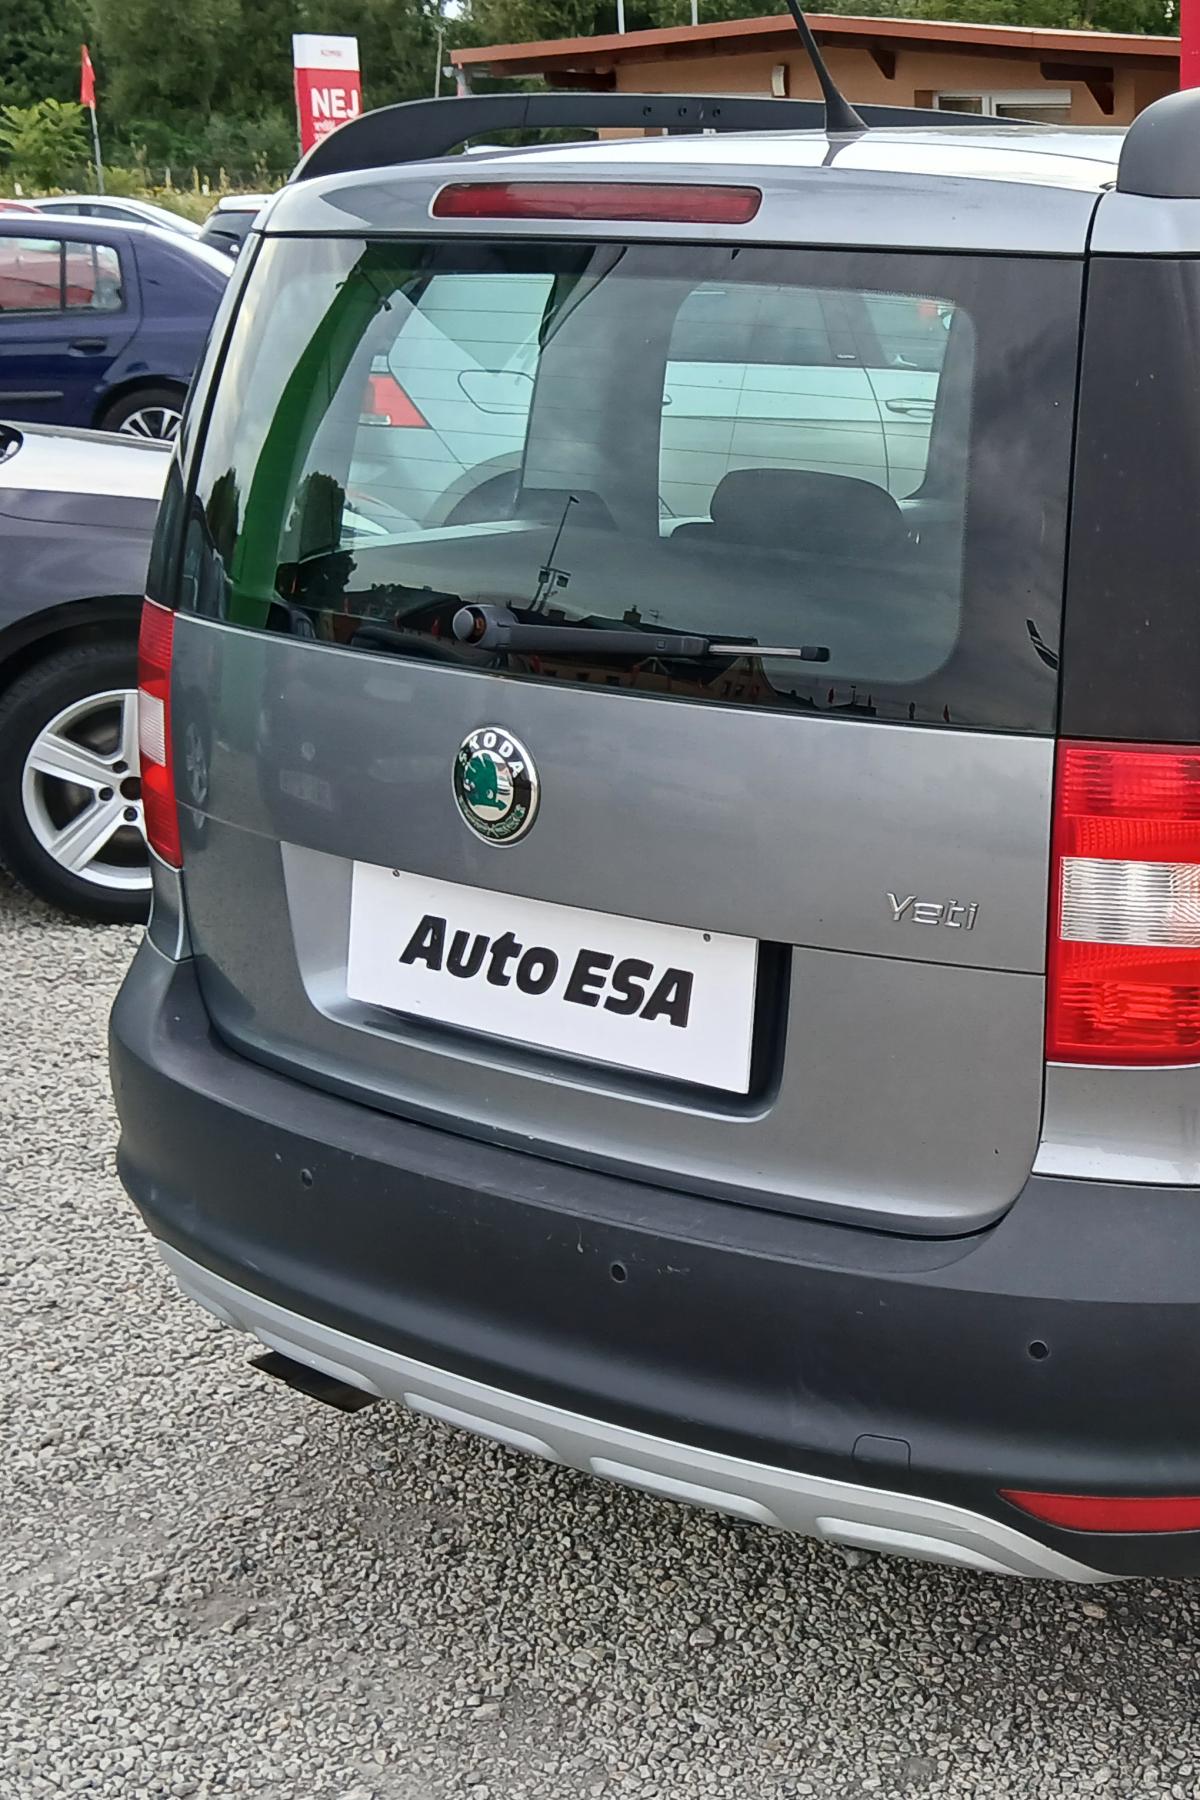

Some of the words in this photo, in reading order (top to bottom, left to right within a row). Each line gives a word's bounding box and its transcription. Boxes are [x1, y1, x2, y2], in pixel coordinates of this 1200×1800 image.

[310, 87, 360, 119] NEJ
[886, 892, 978, 930] Yeti
[399, 914, 559, 995] Auto
[563, 948, 694, 1029] ESA
